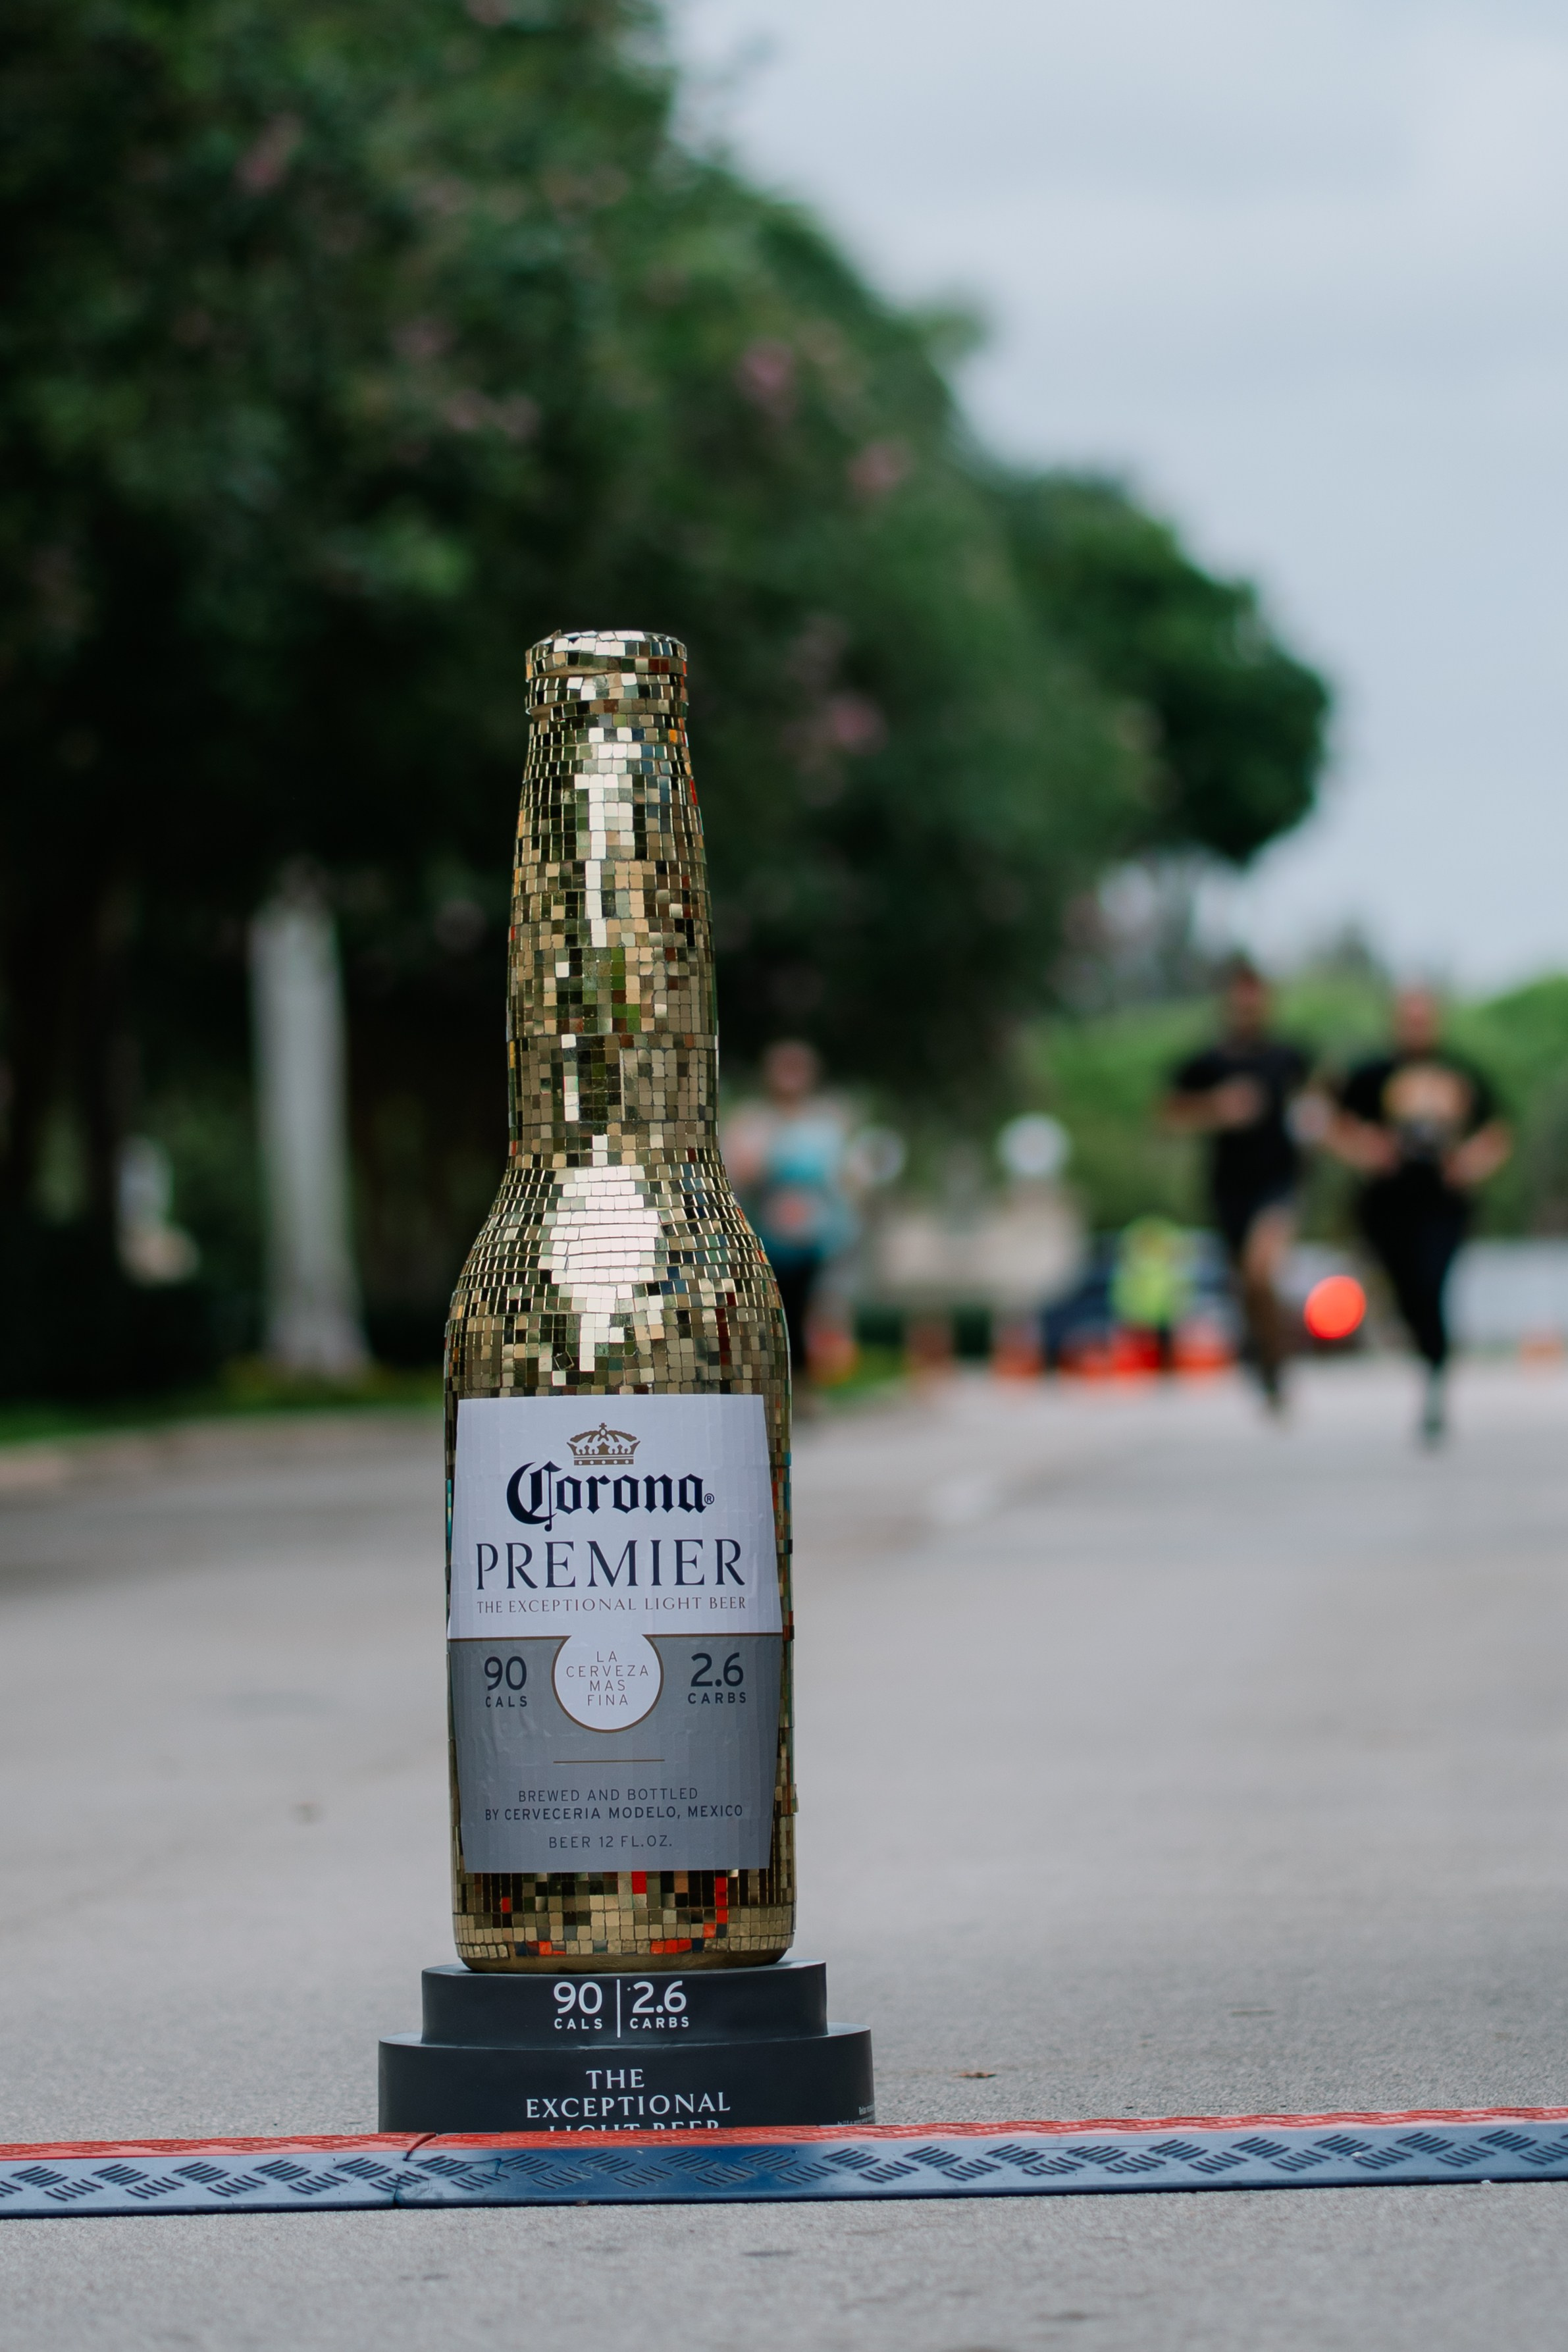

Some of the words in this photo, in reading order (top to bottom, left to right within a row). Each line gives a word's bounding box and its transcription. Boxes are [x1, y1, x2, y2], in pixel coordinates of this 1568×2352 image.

[476, 1538, 746, 1590] PREMIER
[477, 1600, 502, 1614] THE
[509, 1598, 637, 1613] EXCEPTIONAL
[645, 1597, 702, 1610] LIGHT
[710, 1596, 746, 1609] BEER
[596, 1650, 617, 1663] LA
[484, 1656, 527, 1692] 90
[566, 1664, 649, 1678] CERVEZA
[691, 1652, 744, 1687] 2.6
[590, 1679, 625, 1692] MAS
[485, 1695, 527, 1708] CALS
[587, 1694, 628, 1706] FINA
[687, 1691, 746, 1704] CARBS
[518, 1789, 580, 1803] BREWED
[587, 1789, 620, 1801] AND
[627, 1787, 698, 1800] BOTTLED
[485, 1808, 499, 1821] BY
[504, 1807, 601, 1821] CERVECERIA
[609, 1806, 681, 1820] MODELO,
[688, 1804, 743, 1817] MEXICO
[549, 1836, 590, 1849] BEER
[598, 1835, 614, 1848] 12
[553, 1981, 603, 2014] 90
[632, 1980, 687, 2014] 2.6
[554, 2018, 603, 2029] CALS
[629, 2016, 689, 2029] CARBS
[585, 2068, 645, 2089] THE
[526, 2091, 731, 2118] EXCEPTIONAL
